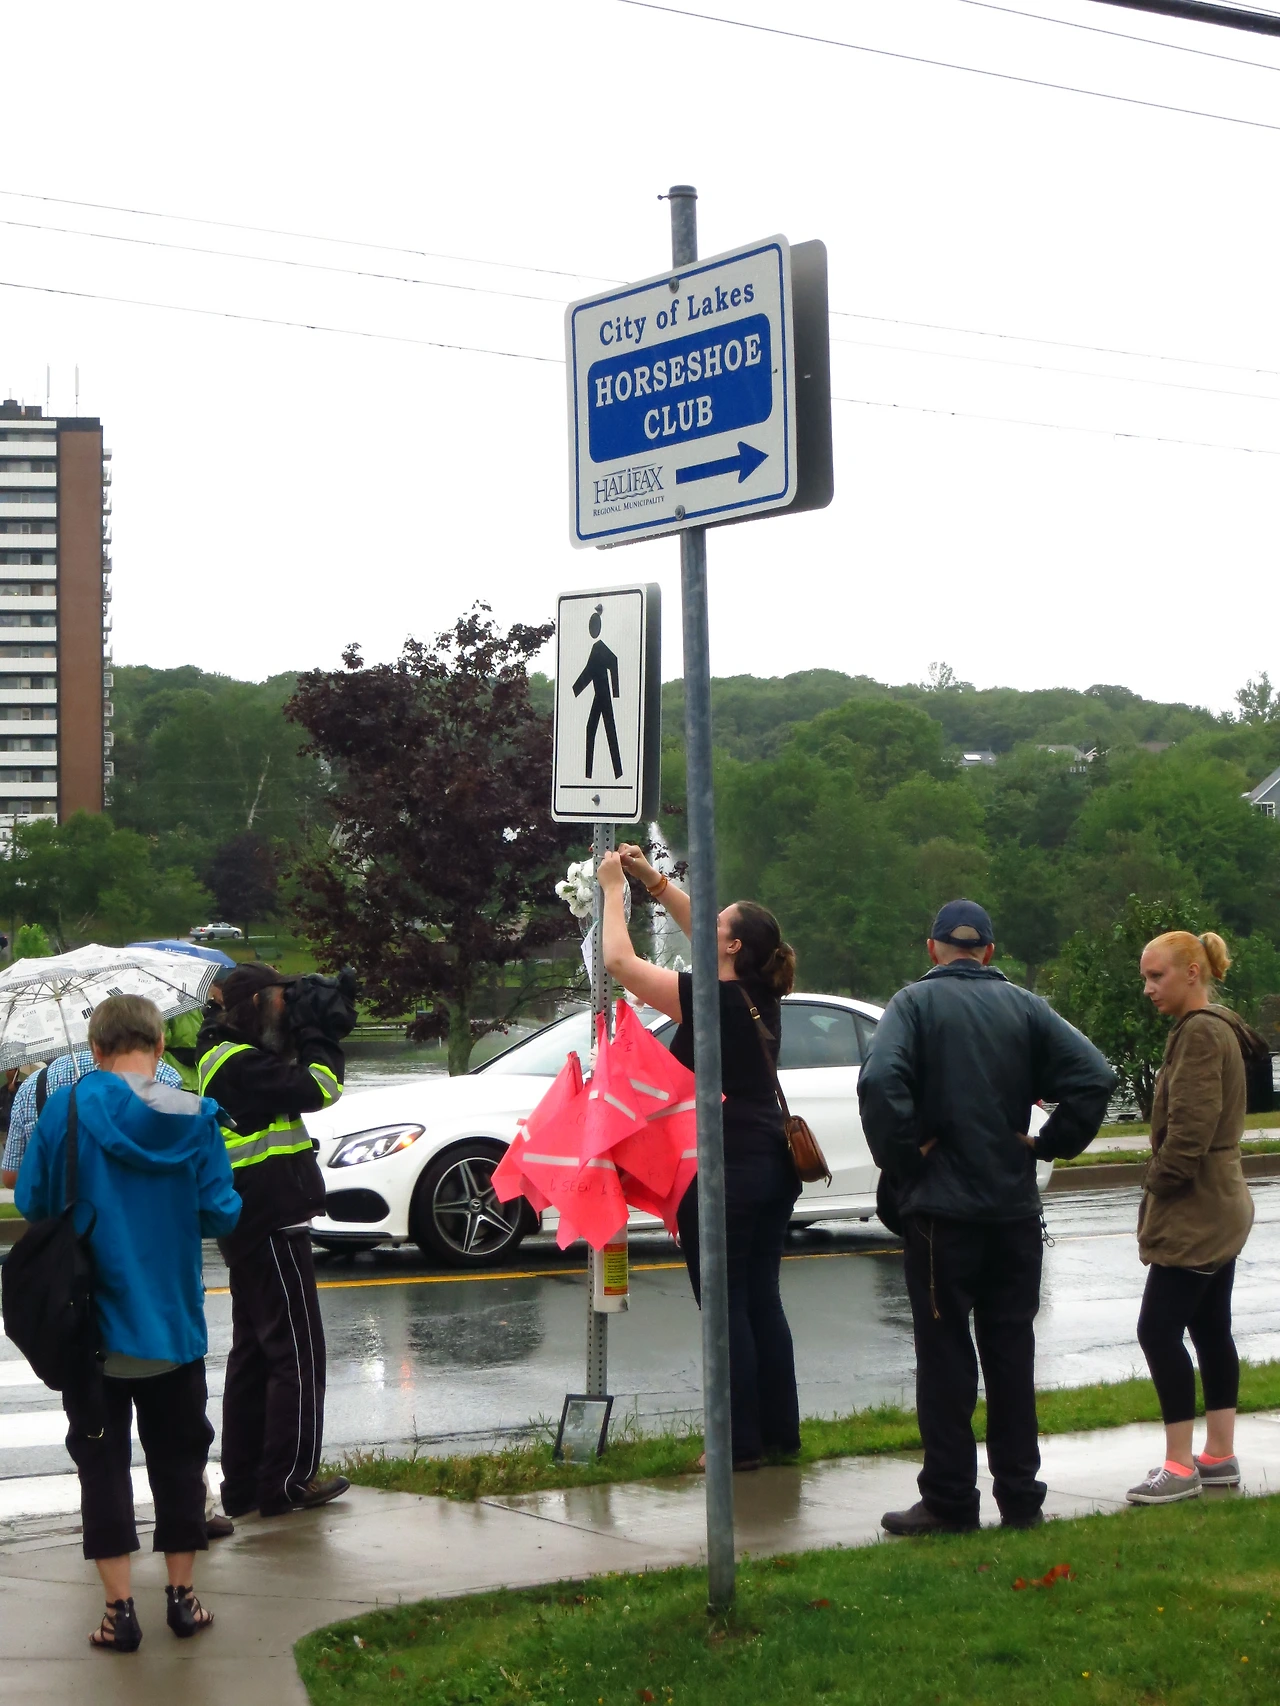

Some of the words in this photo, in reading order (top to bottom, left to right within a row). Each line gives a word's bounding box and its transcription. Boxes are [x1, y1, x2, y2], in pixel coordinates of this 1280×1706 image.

[599, 314, 647, 346] City
[656, 300, 679, 330] of
[687, 282, 755, 319] Lakes
[595, 333, 762, 408] HORSESHOE
[643, 395, 714, 440] CLUB
